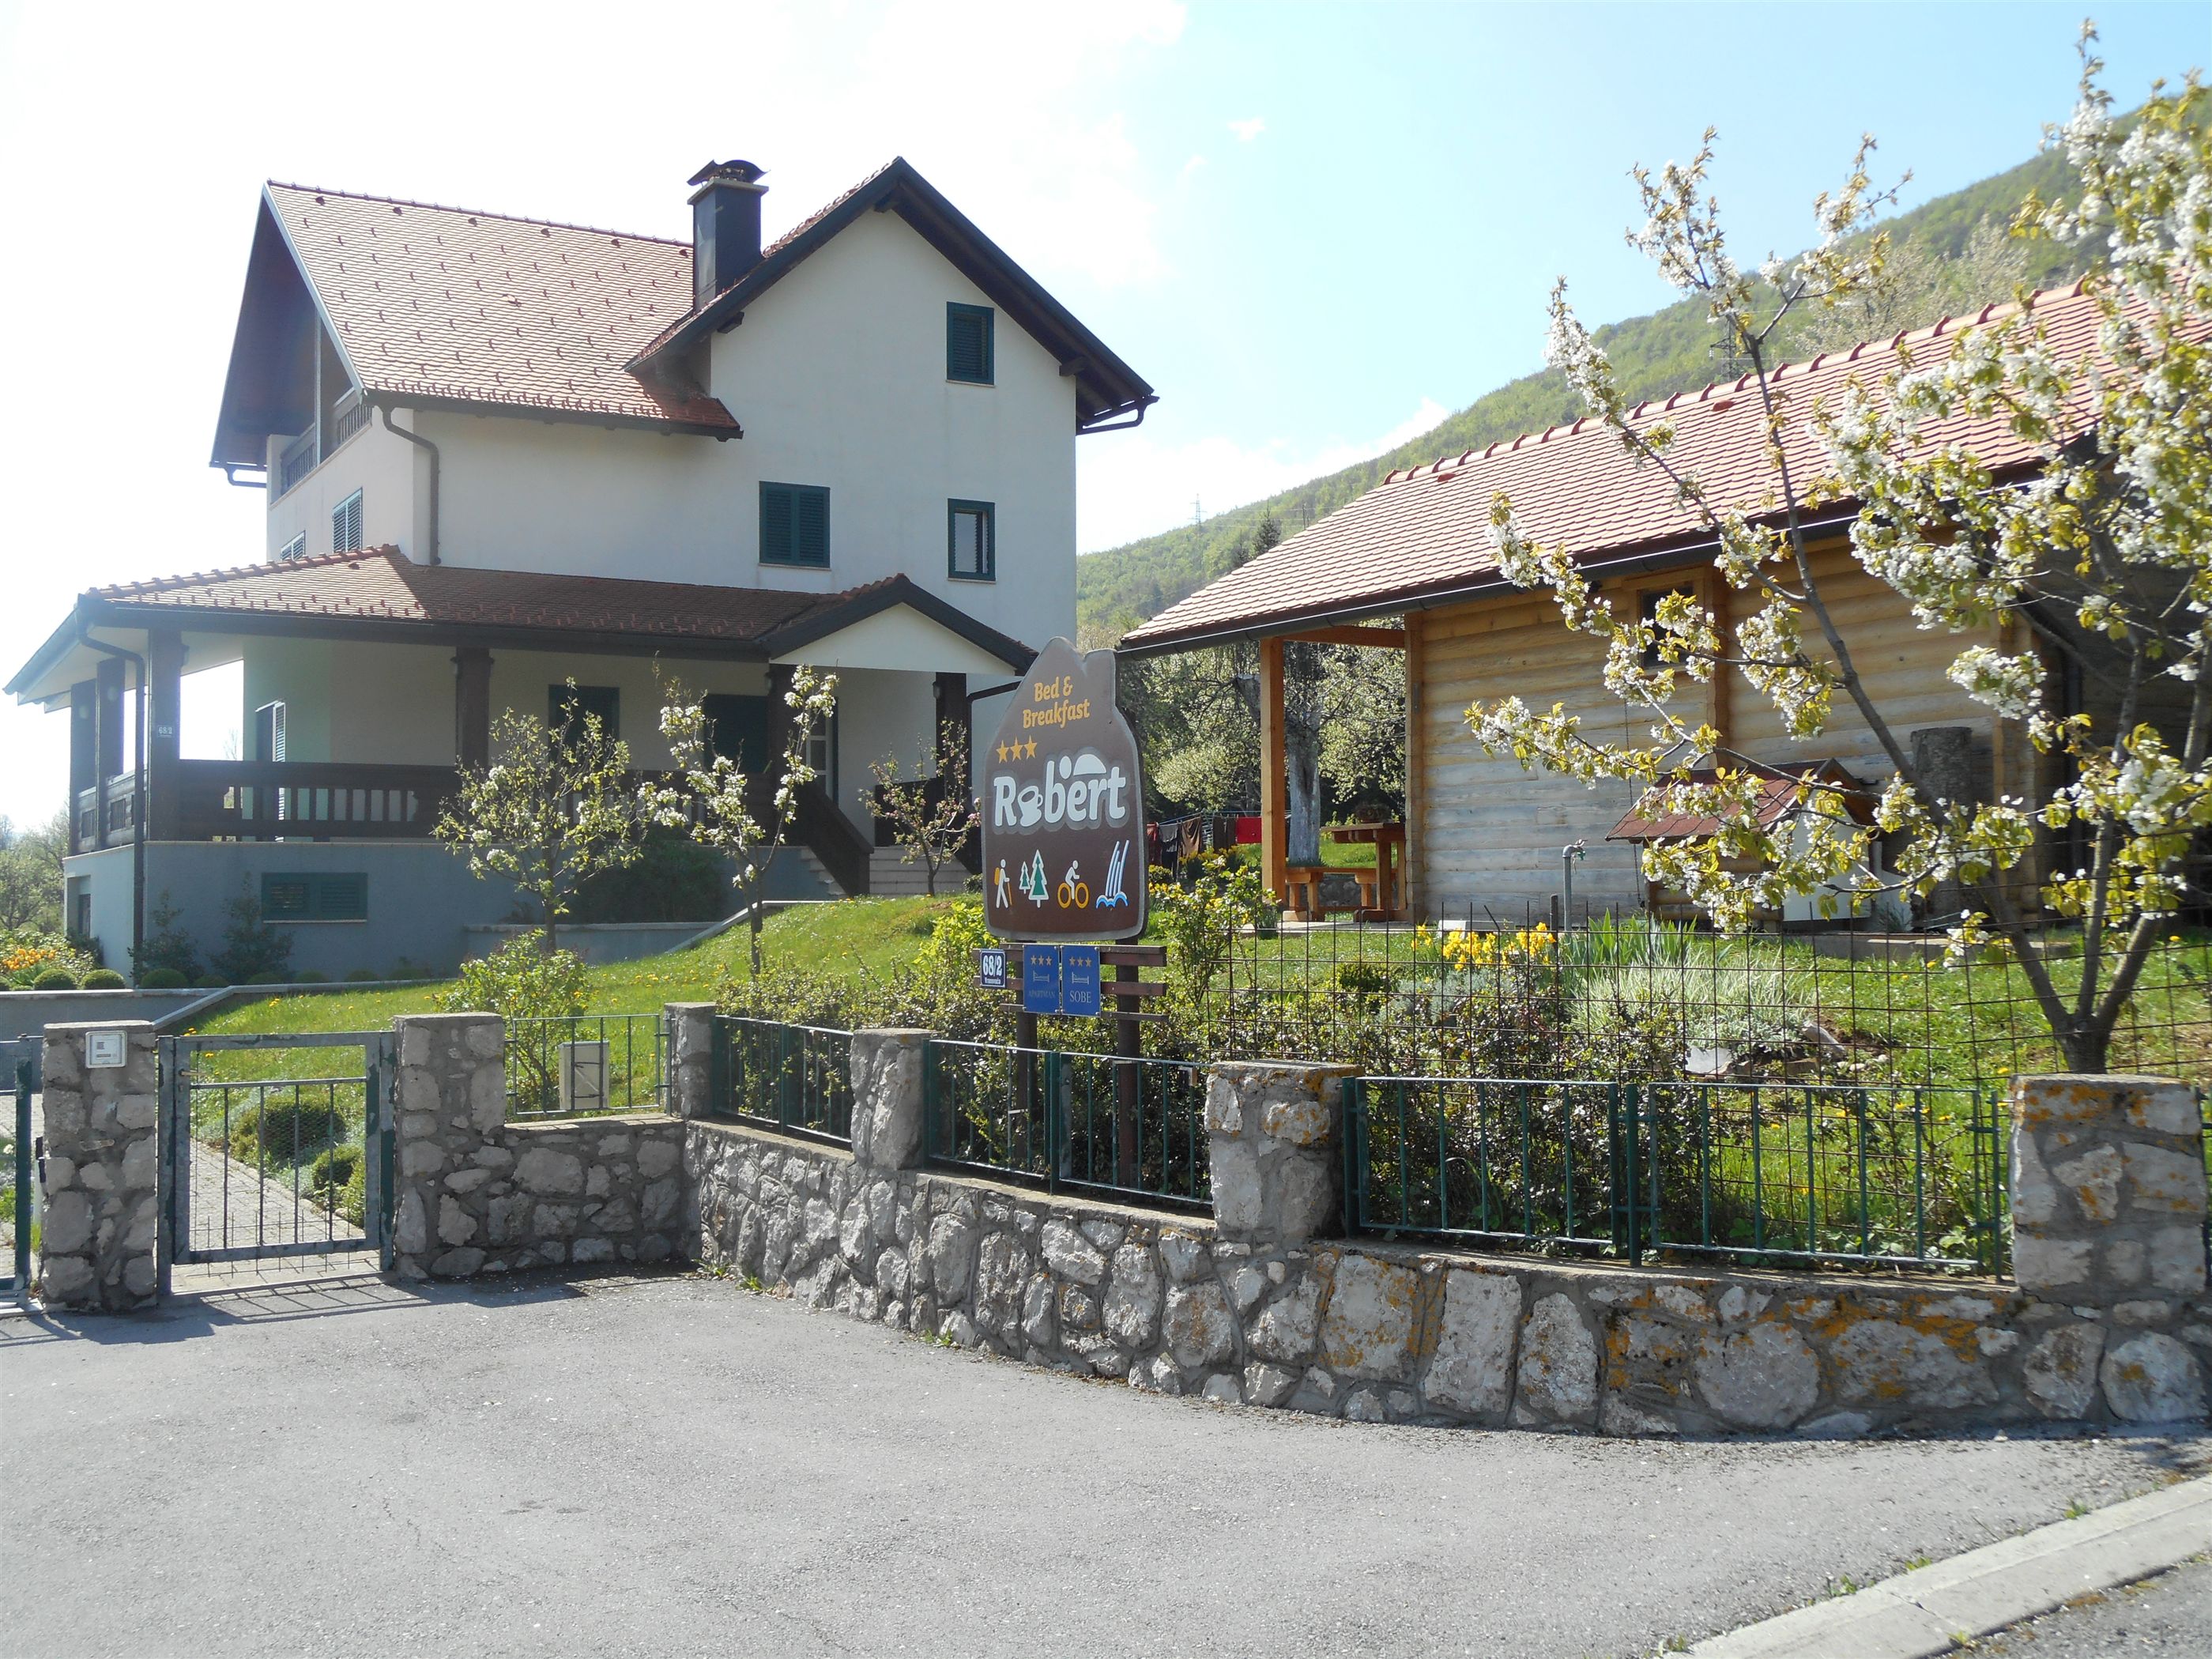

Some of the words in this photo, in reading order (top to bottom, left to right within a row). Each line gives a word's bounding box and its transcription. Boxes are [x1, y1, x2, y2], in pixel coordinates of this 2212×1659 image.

[1034, 677, 1060, 702] Bed
[1063, 676, 1073, 696] &
[1023, 699, 1091, 728] Breakfast
[993, 759, 1126, 827] Robert
[982, 955, 1003, 977] 68/2
[1069, 990, 1092, 1004] SOBE
